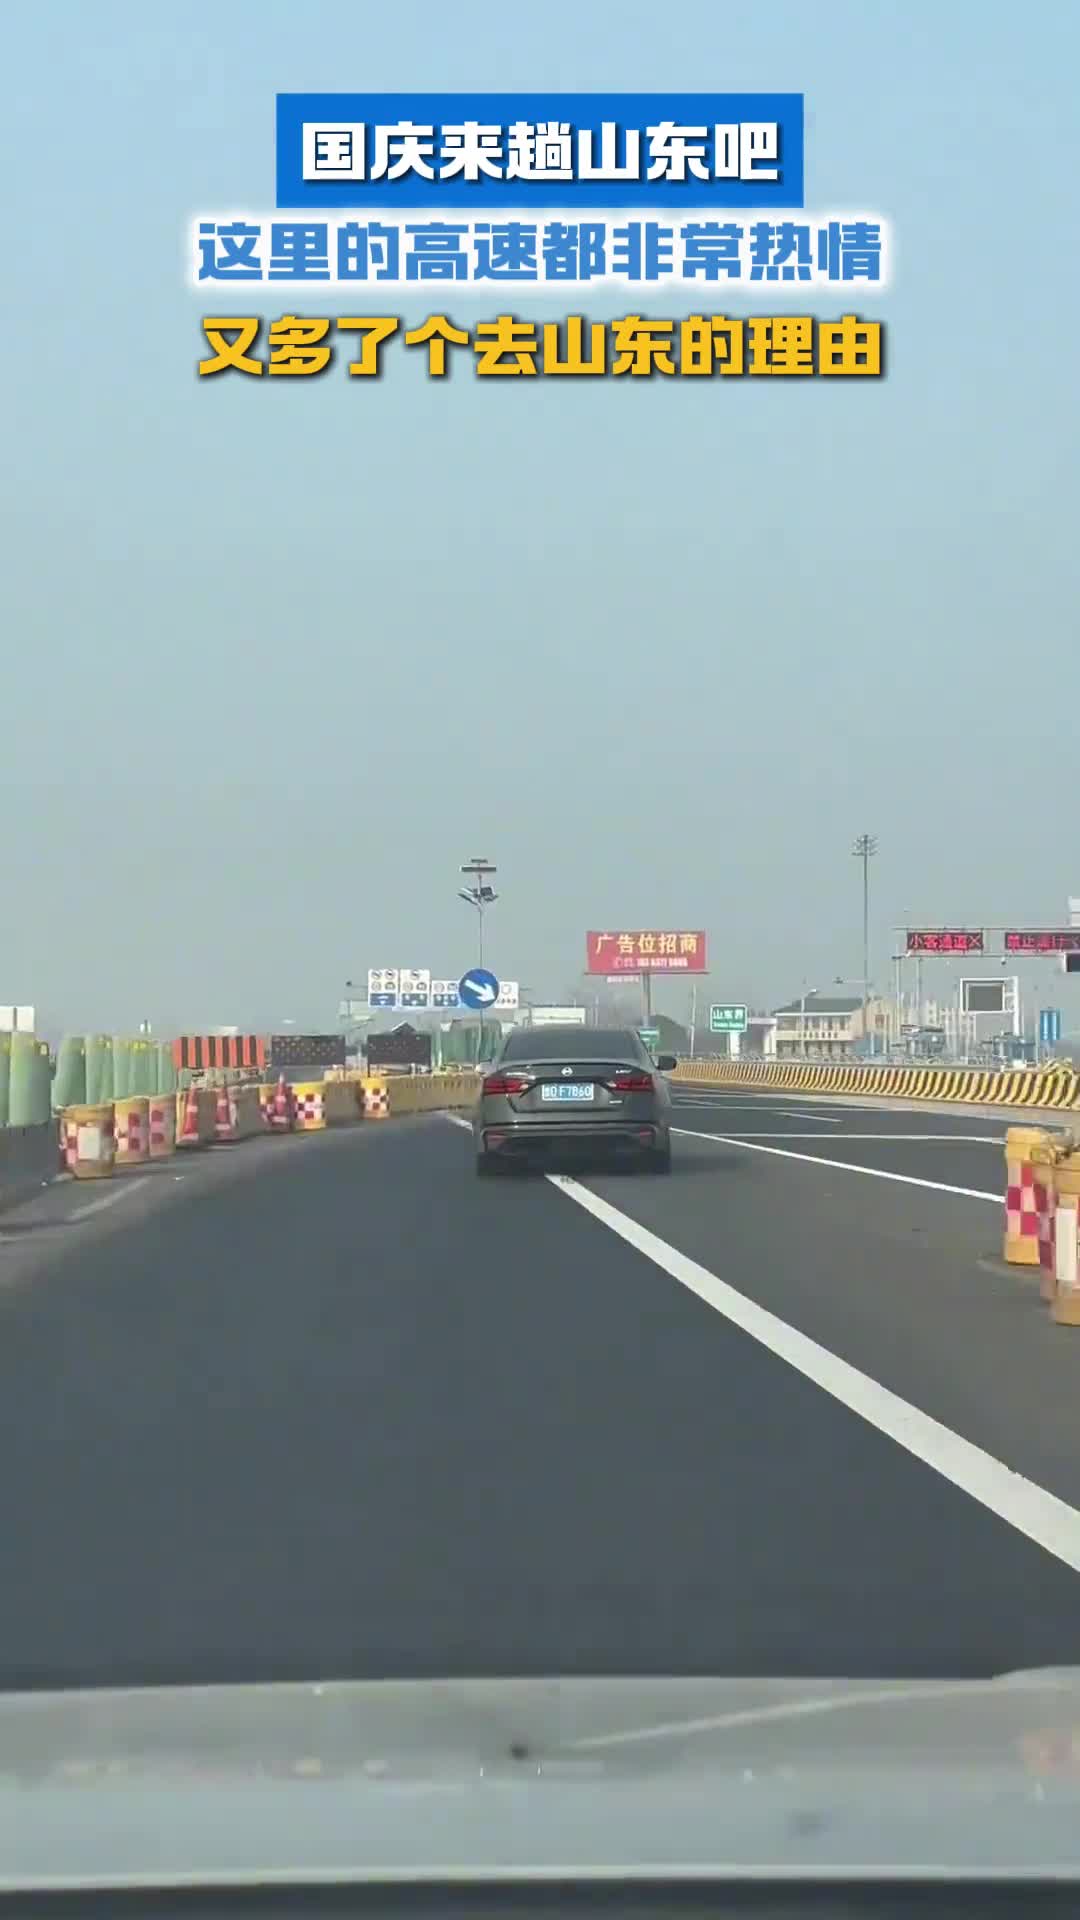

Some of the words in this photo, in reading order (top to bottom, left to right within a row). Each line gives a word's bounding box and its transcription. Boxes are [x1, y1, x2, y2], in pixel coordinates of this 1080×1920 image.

[595, 933, 698, 954] 广告位招商
